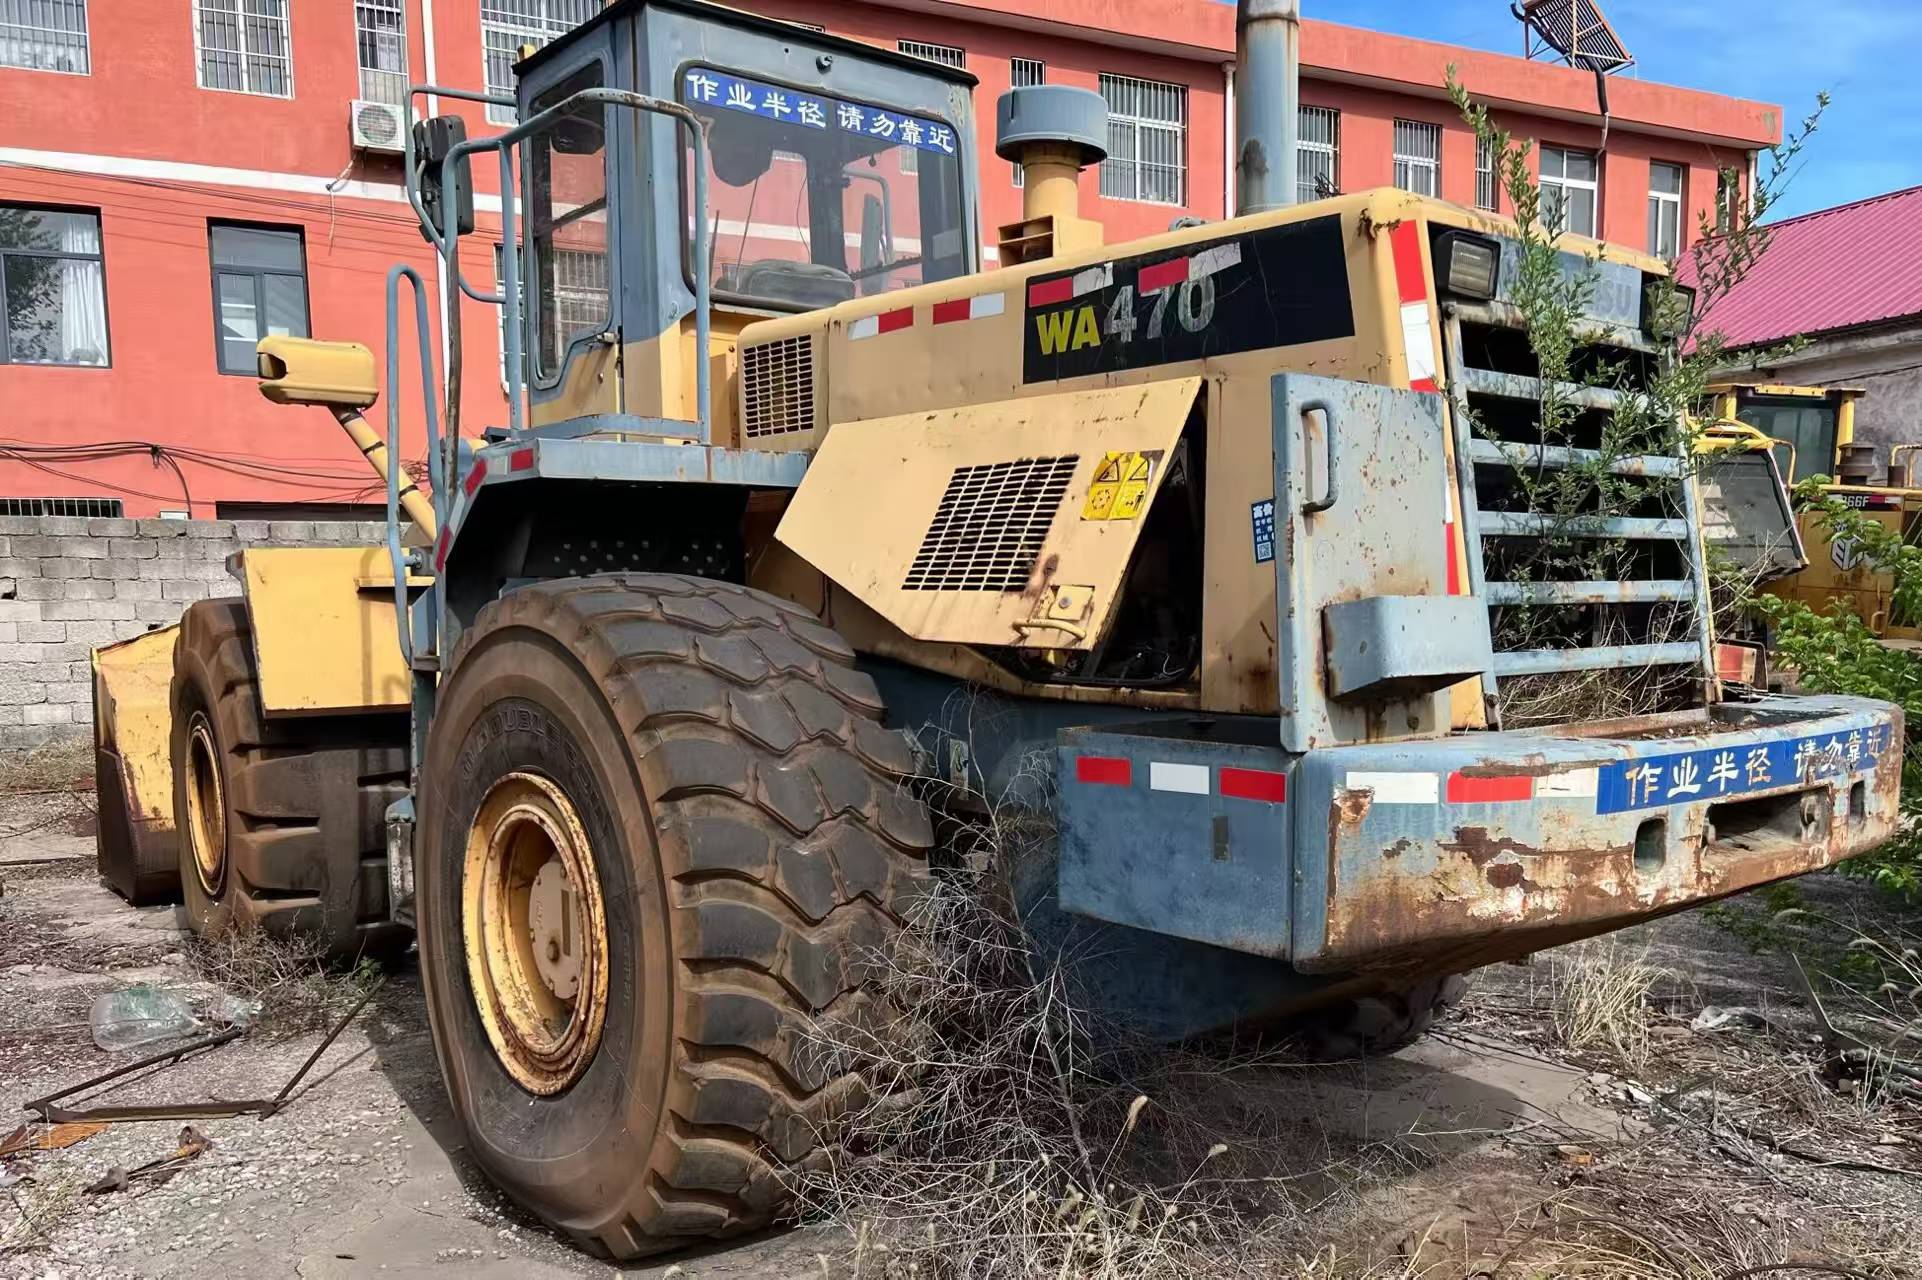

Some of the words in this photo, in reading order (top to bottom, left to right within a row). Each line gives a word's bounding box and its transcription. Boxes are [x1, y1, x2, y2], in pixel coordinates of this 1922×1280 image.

[687, 74, 826, 128] 作业半径
[837, 105, 954, 154] 请勿靠近
[1625, 747, 1772, 807] 作业半径
